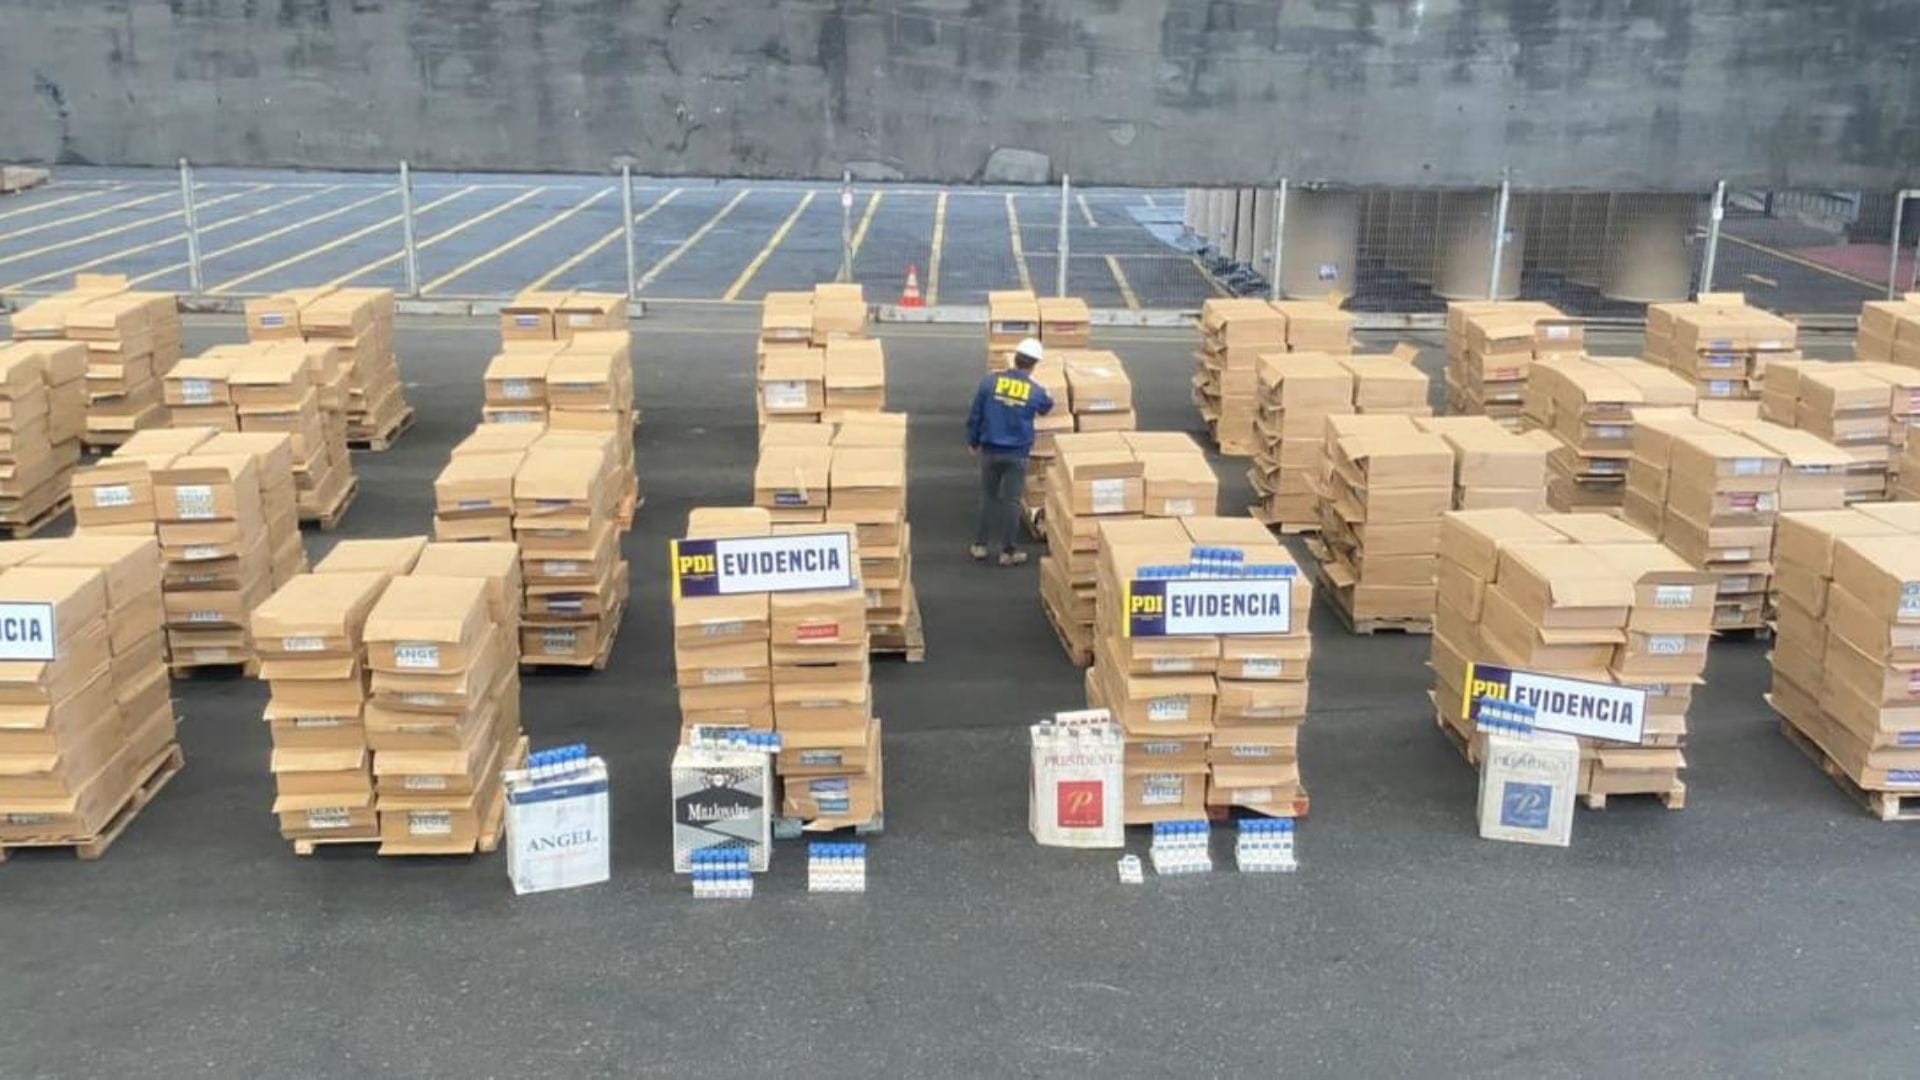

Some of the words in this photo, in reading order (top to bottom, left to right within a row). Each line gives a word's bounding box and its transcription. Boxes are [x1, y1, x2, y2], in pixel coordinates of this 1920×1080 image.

[994, 377, 1031, 401] PDI
[678, 554, 715, 574] PDI
[723, 548, 841, 577] EVIDENCIA
[1130, 594, 1164, 613] PDI
[1171, 592, 1282, 618] EVIDENCIA
[0, 617, 43, 642] CIA
[1472, 678, 1506, 700] PDI
[525, 829, 599, 853] ANGEL
